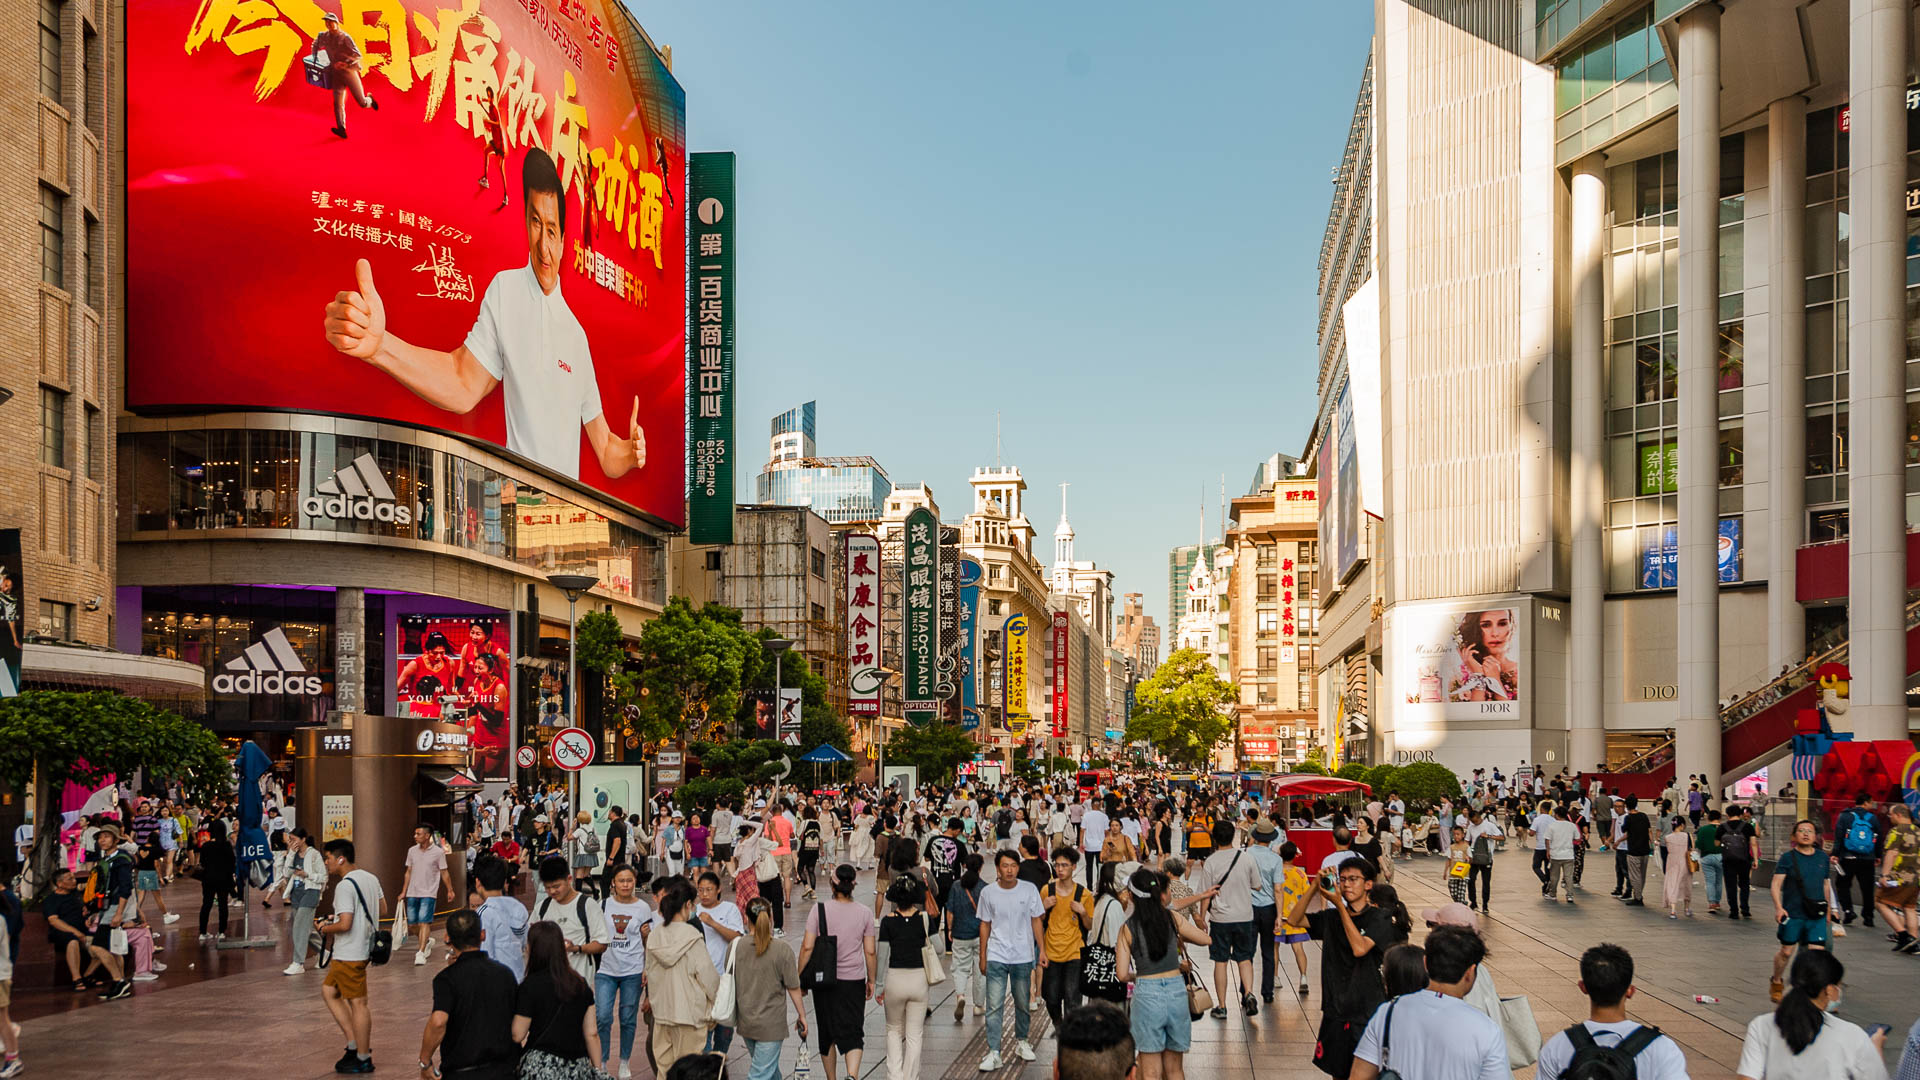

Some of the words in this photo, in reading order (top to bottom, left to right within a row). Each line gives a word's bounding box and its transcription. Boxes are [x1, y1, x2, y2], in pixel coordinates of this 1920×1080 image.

[313, 216, 414, 252] 文化传播大使
[699, 233, 722, 418] 第一百货商业中心
[696, 440, 705, 484] CENTER
[716, 439, 725, 464] NO.1
[706, 440, 715, 497] SHOPPING
[303, 494, 411, 525] adidas
[909, 522, 932, 609] 茂昌眼镜
[850, 552, 876, 666] 泰康食品
[1542, 605, 1561, 622] DIOR
[213, 669, 323, 696] adidas
[408, 695, 433, 703] YOU
[473, 694, 500, 703] THIS
[1480, 703, 1511, 713] DIOR
[1398, 750, 1435, 763] DIOR
